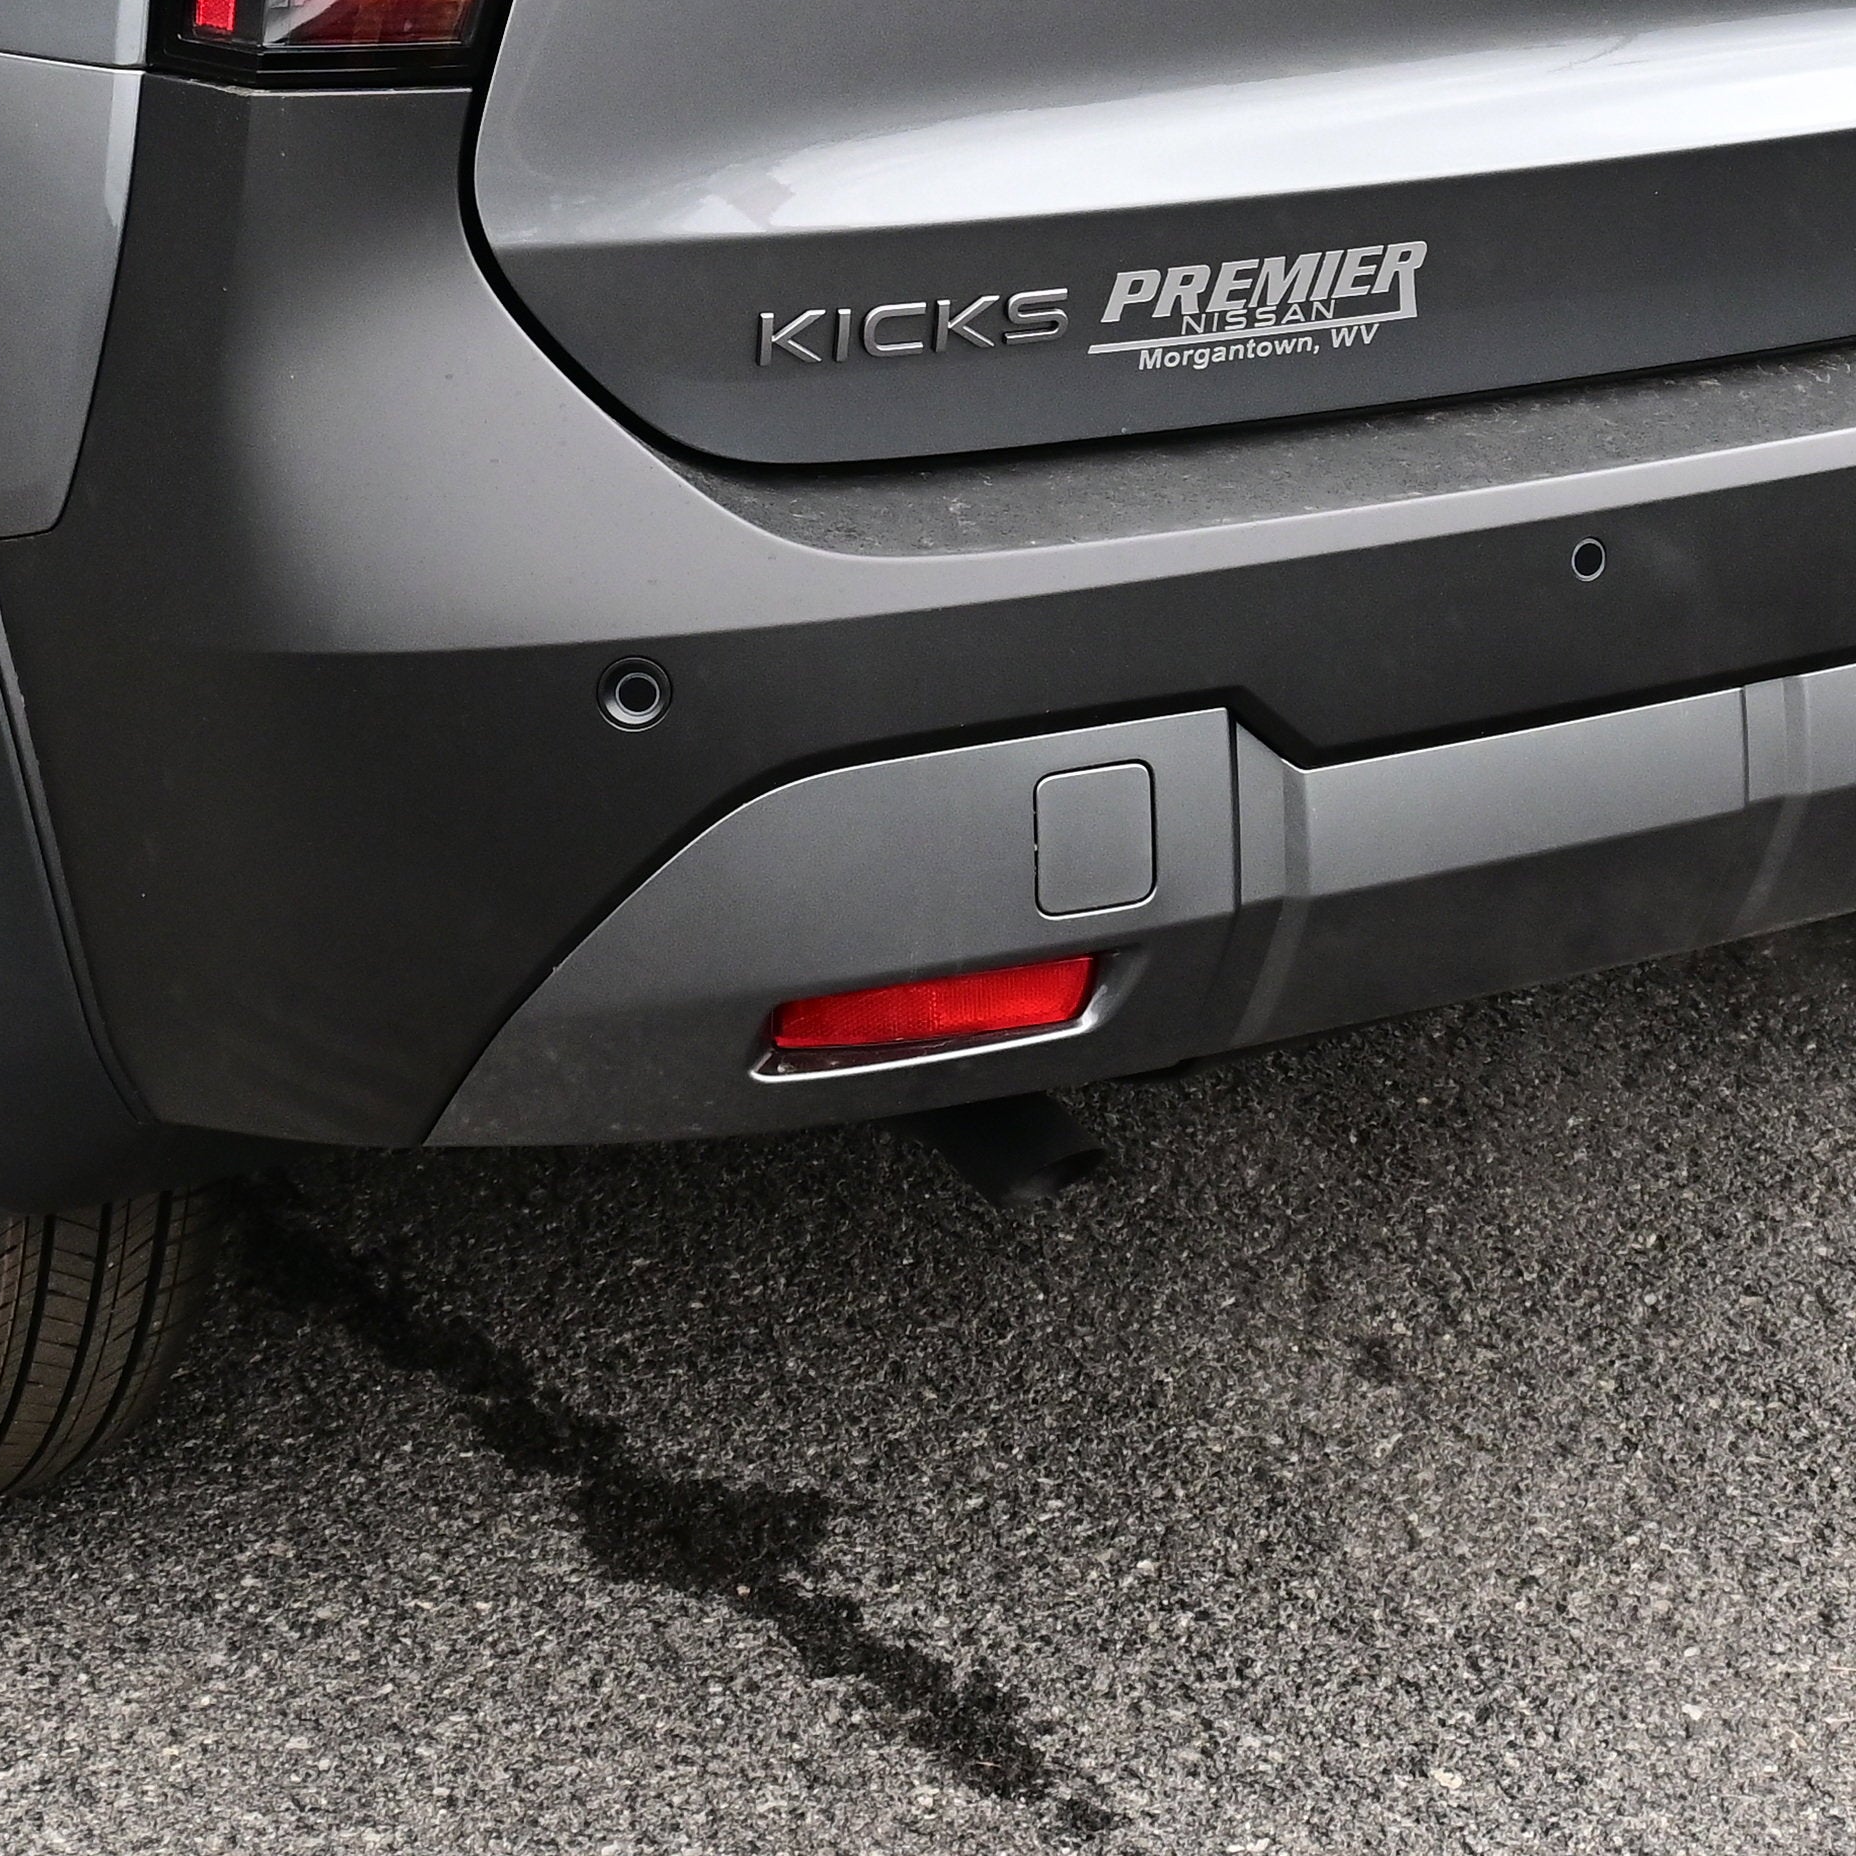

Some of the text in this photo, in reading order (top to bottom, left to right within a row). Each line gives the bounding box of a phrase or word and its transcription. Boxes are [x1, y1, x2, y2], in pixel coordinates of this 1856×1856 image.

[1100, 240, 1428, 324] PREMIER
[758, 286, 1069, 366] KICKS
[1138, 323, 1380, 370] Morgantown, WV
[1180, 300, 1336, 336] NISSAN
